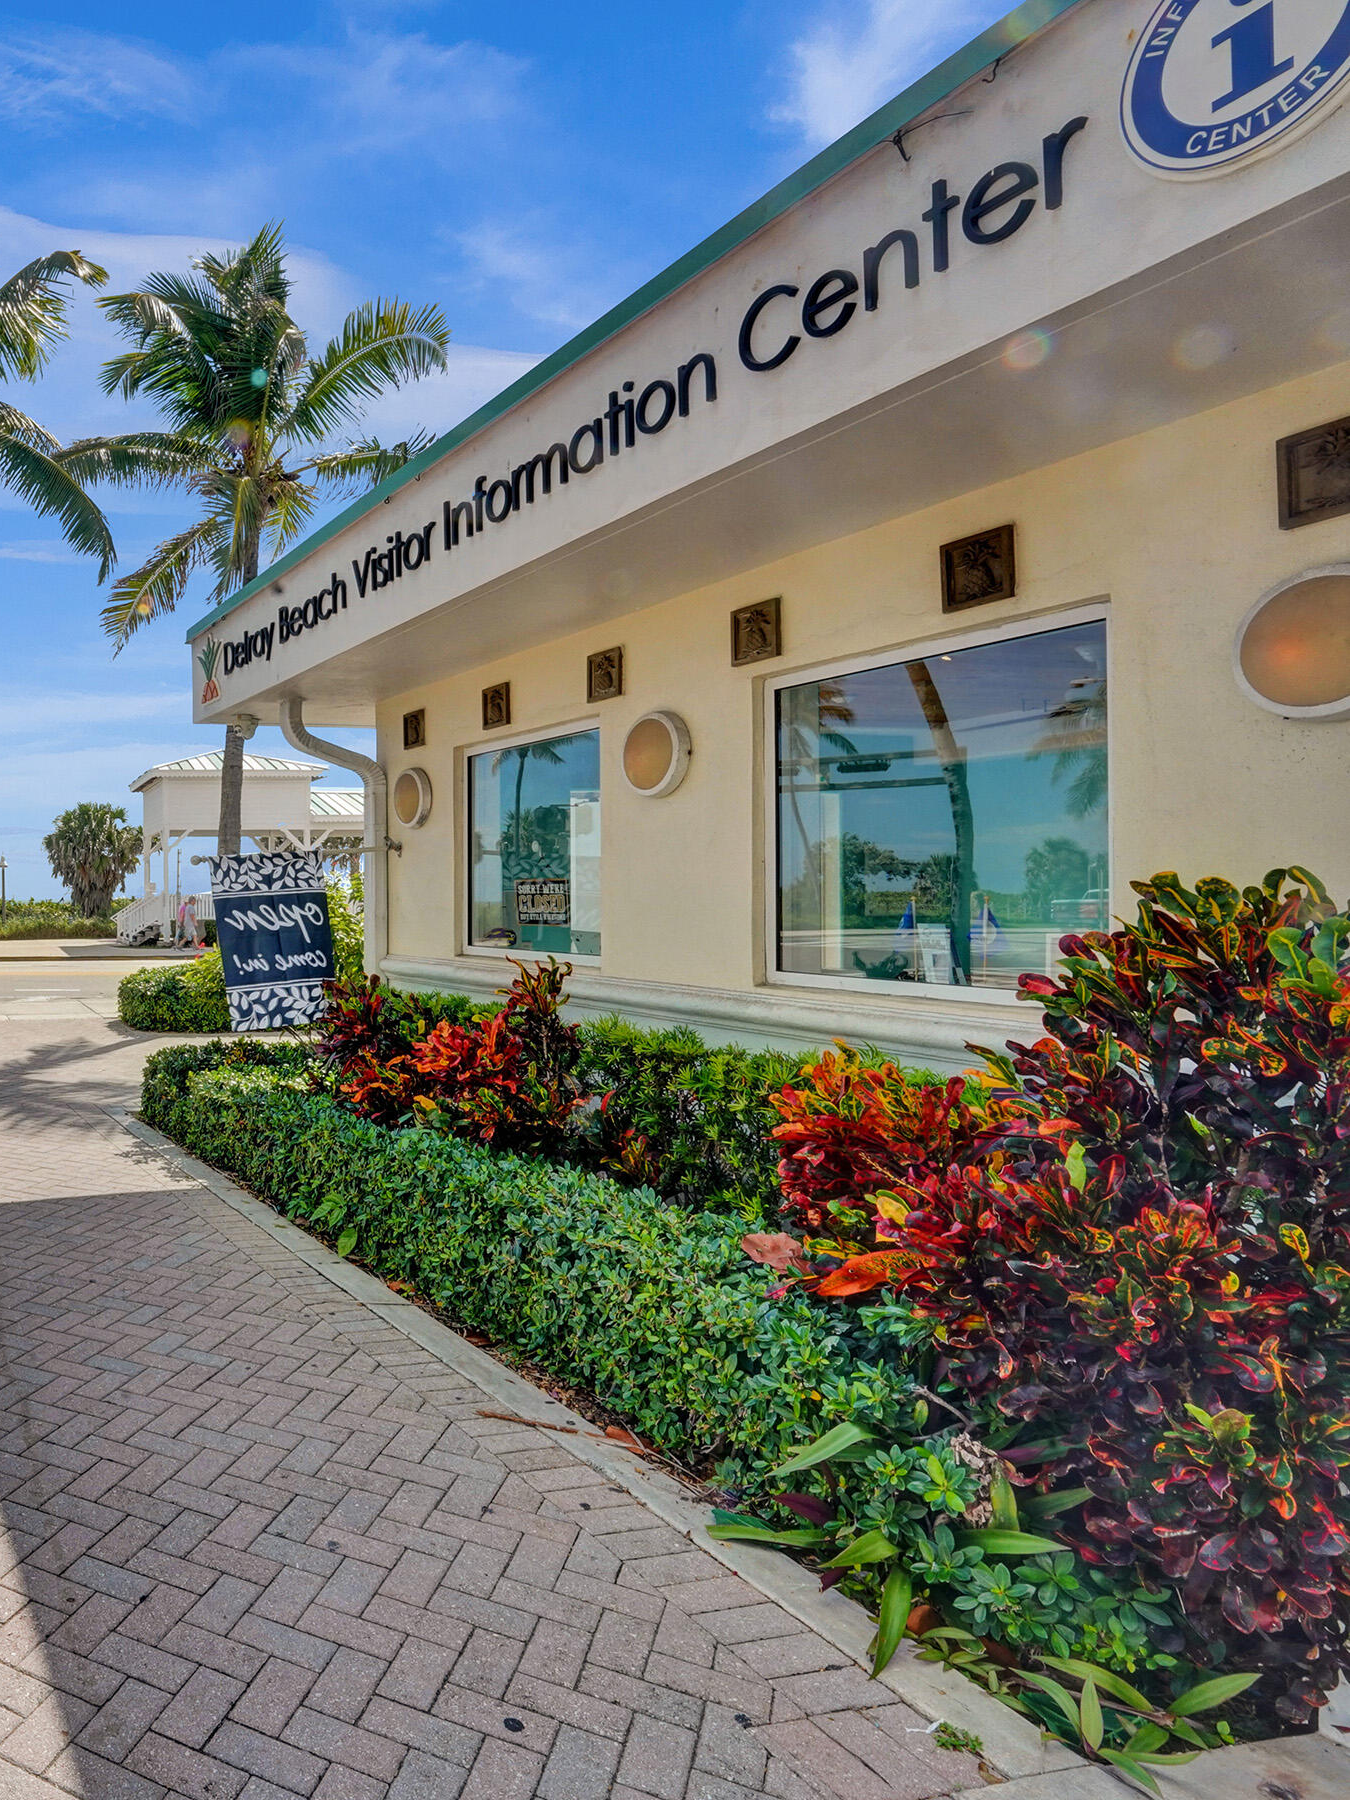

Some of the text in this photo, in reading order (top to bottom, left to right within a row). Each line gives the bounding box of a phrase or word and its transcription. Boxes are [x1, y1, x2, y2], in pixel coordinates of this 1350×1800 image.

[1186, 64, 1331, 154] CENTER
[223, 116, 1089, 676] Delray Beach Visitor Information Center
[517, 884, 540, 894] SORRY
[518, 894, 566, 913] CLOSED
